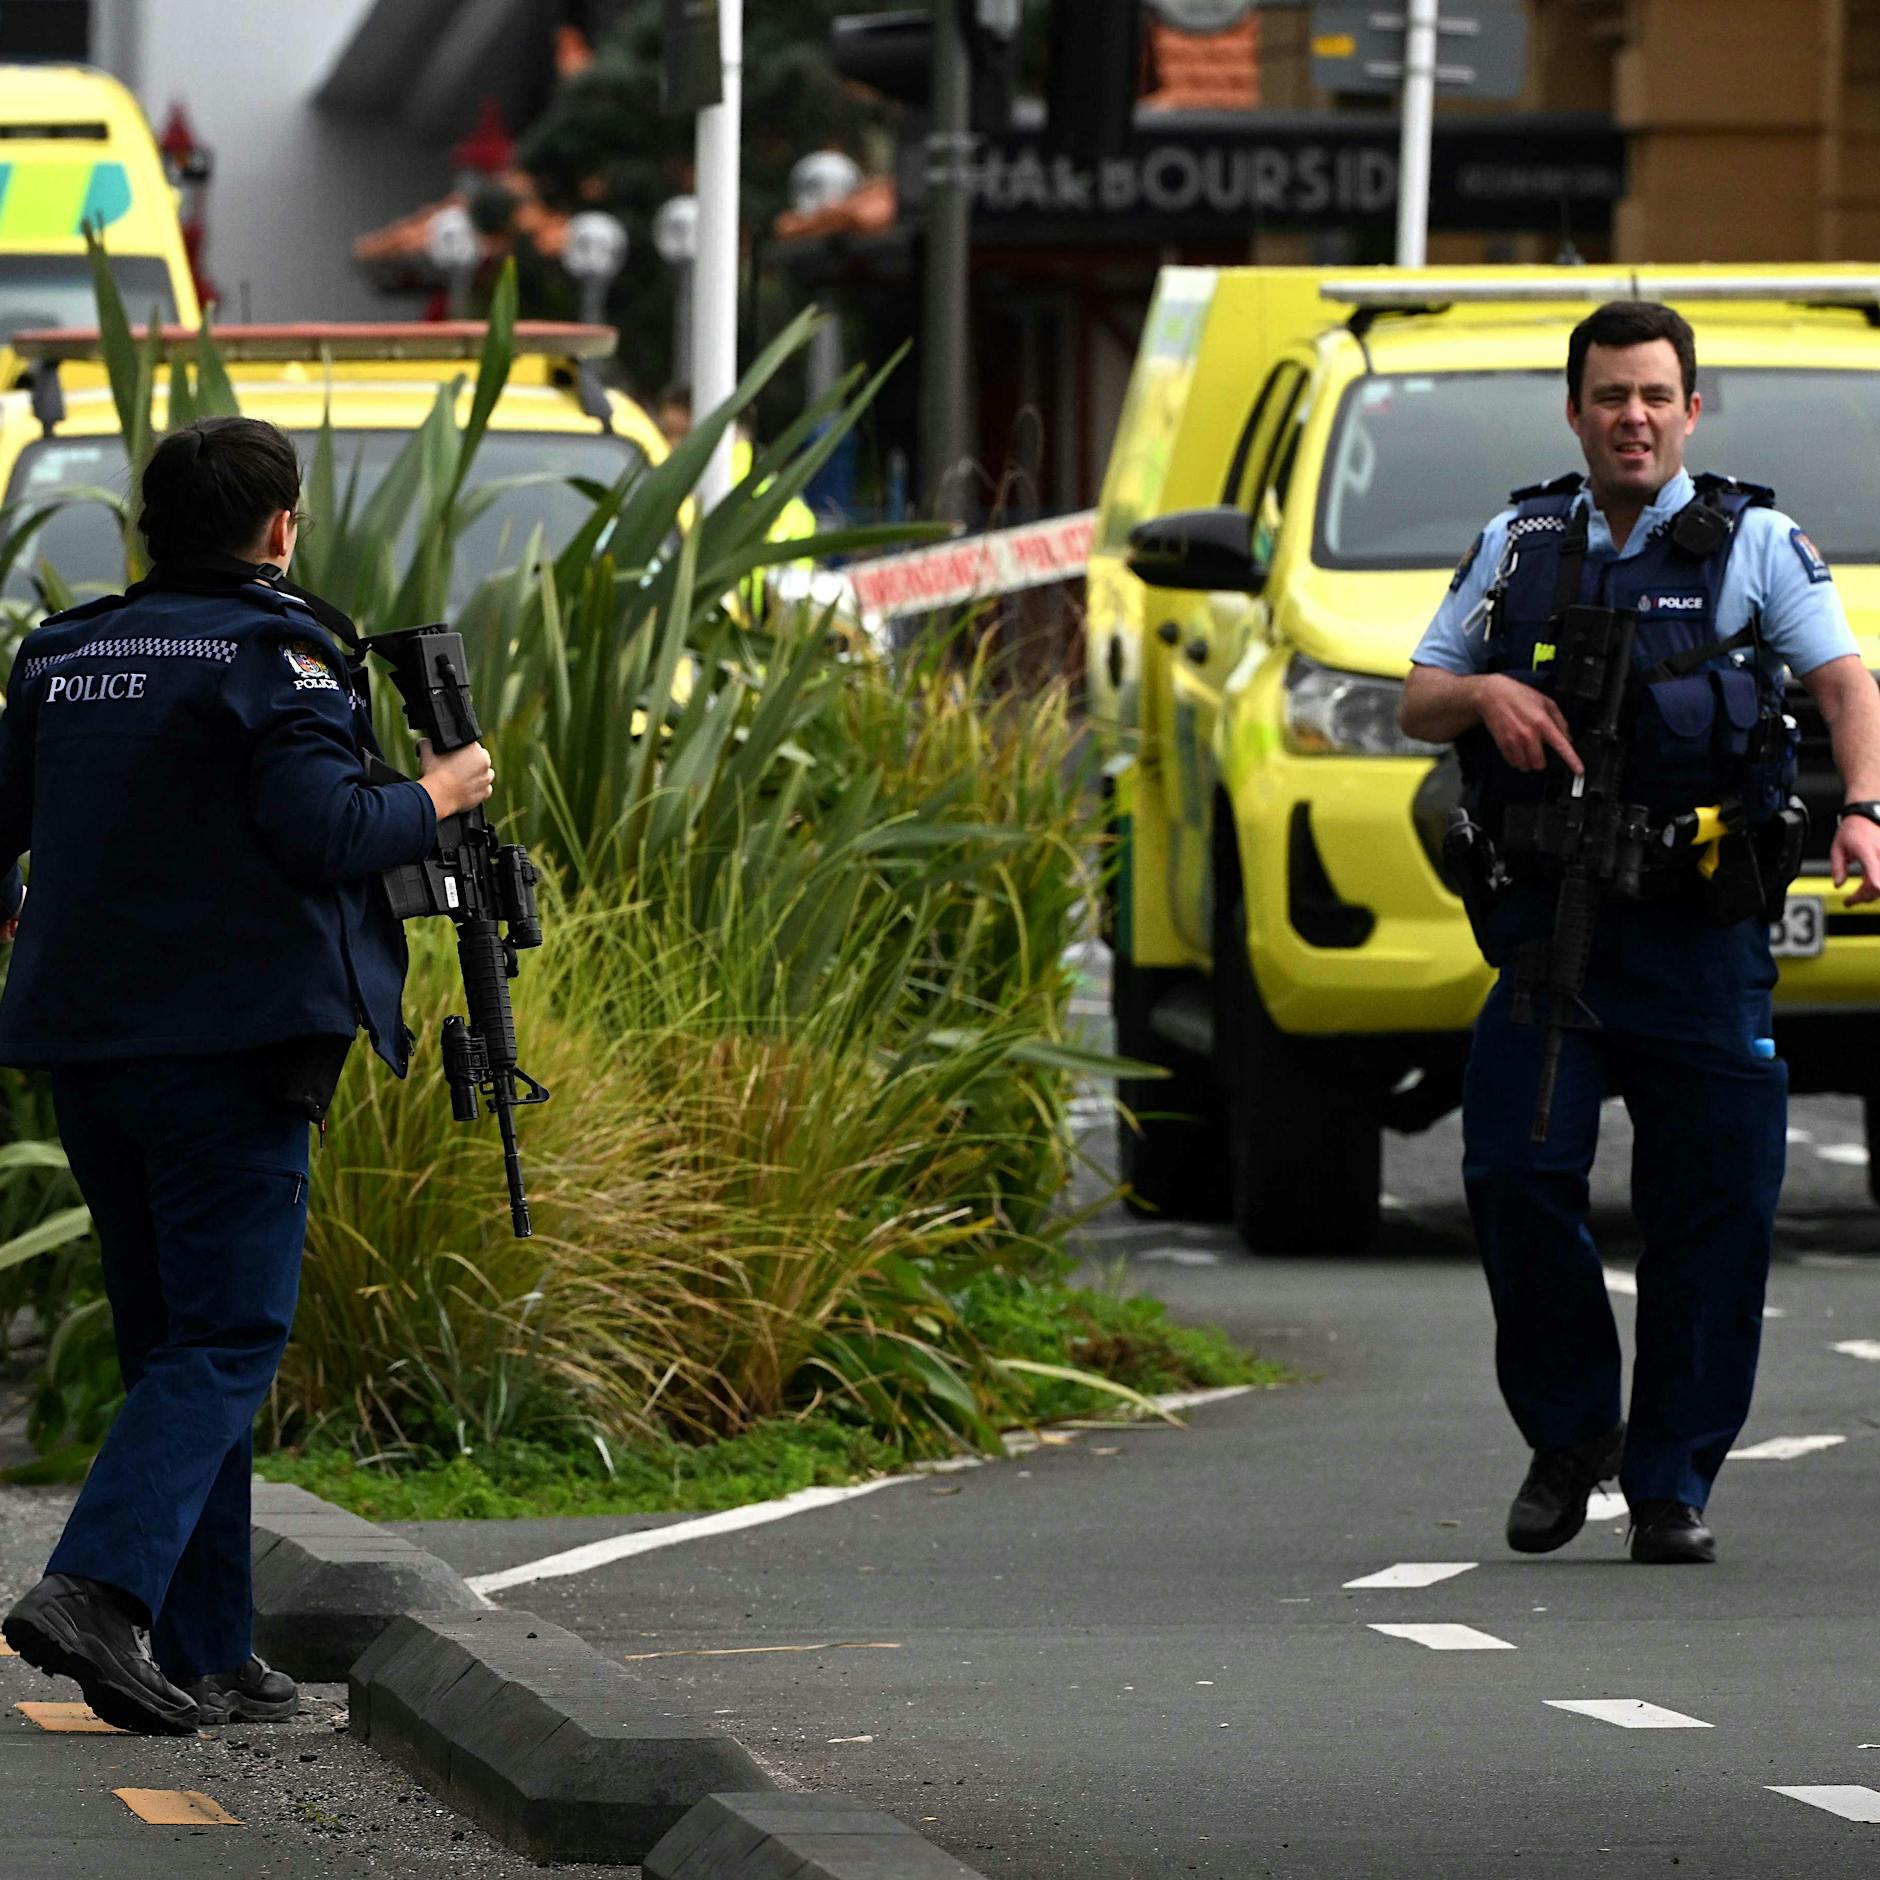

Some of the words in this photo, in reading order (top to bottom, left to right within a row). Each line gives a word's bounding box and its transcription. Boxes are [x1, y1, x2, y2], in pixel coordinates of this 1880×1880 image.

[978, 145, 1399, 210] HARBOURSID
[1658, 597, 1703, 609] POLICE
[46, 672, 147, 702] POLICE
[293, 678, 340, 691] POLICE
